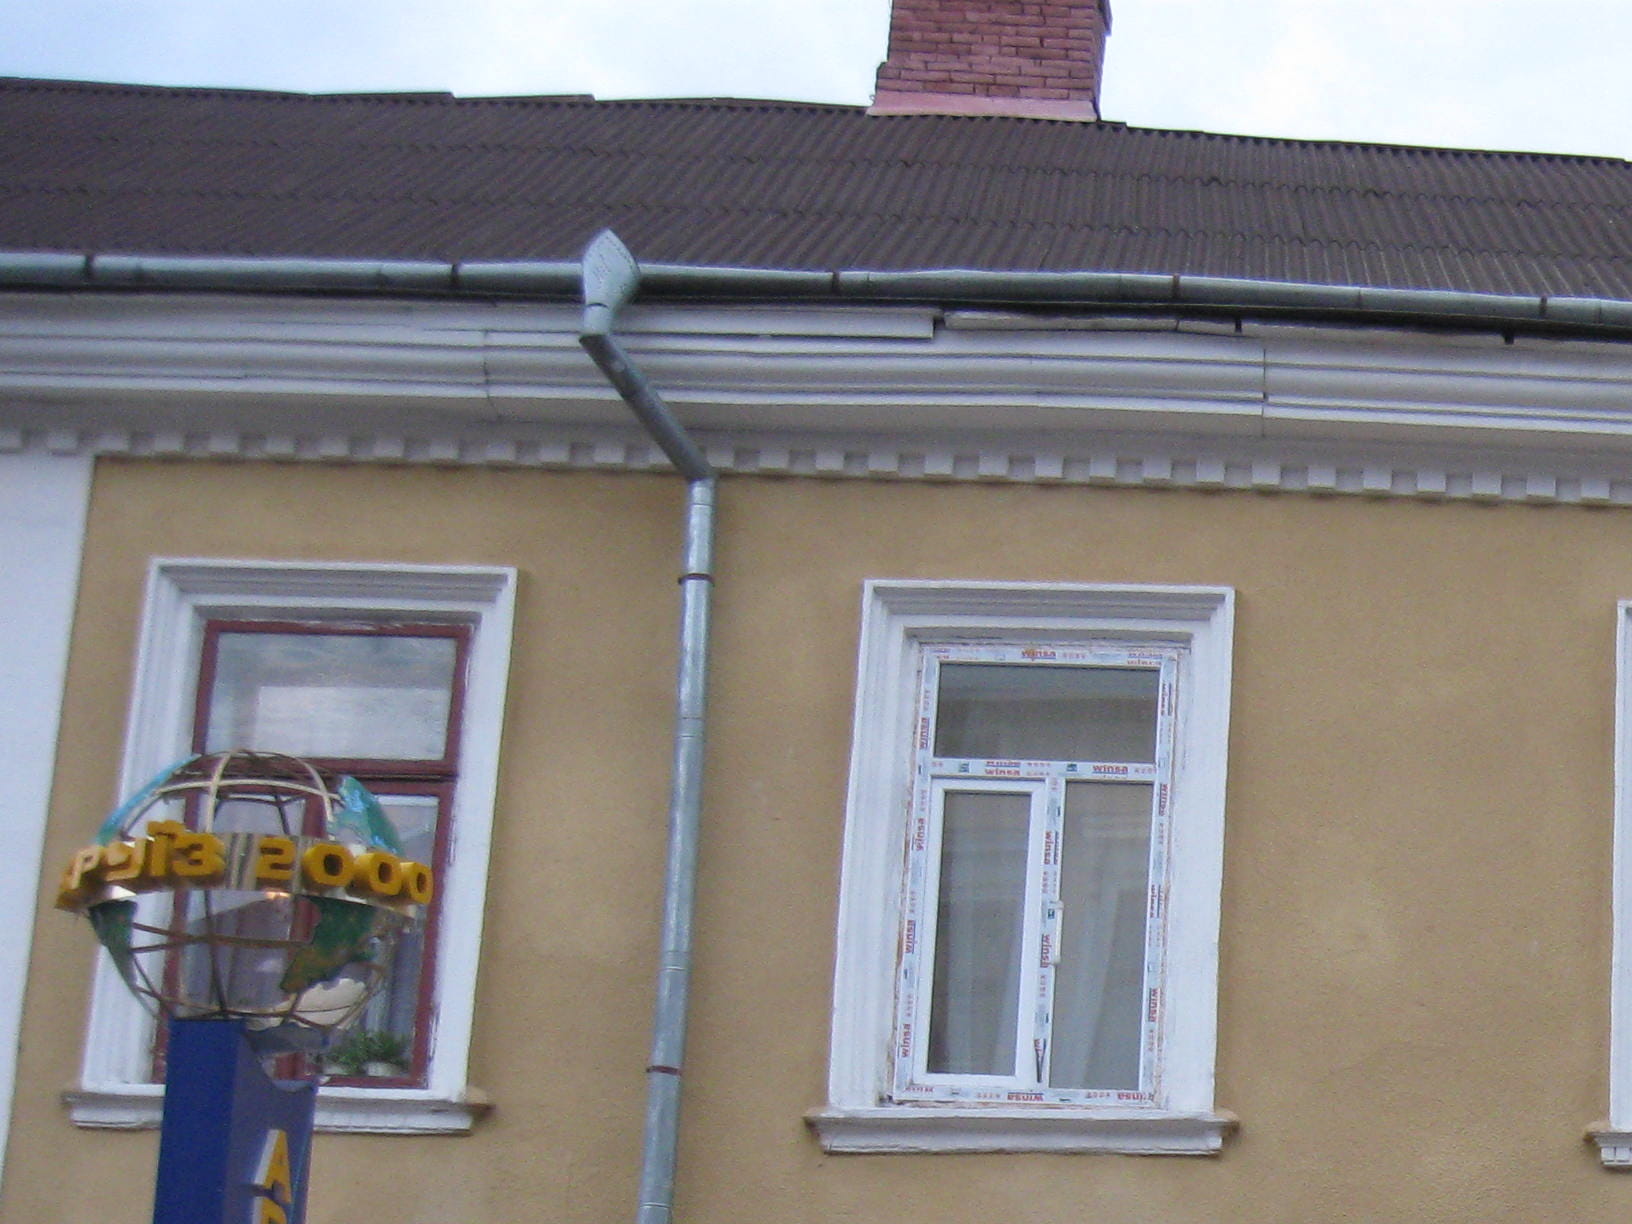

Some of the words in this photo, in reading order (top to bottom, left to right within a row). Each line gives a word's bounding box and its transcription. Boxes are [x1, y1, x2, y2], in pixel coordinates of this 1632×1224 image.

[1021, 649, 1056, 661] winsa
[919, 717, 930, 750] winsa
[1092, 764, 1128, 775] winsa
[916, 817, 925, 852] winsa
[1044, 831, 1053, 865] winsa
[256, 838, 434, 907] 2000
[905, 920, 915, 953] winsa
[1040, 934, 1051, 968] winsa
[1149, 988, 1159, 1022] winsa
[902, 1024, 911, 1058] winsa
[1007, 1092, 1044, 1101] winsa
